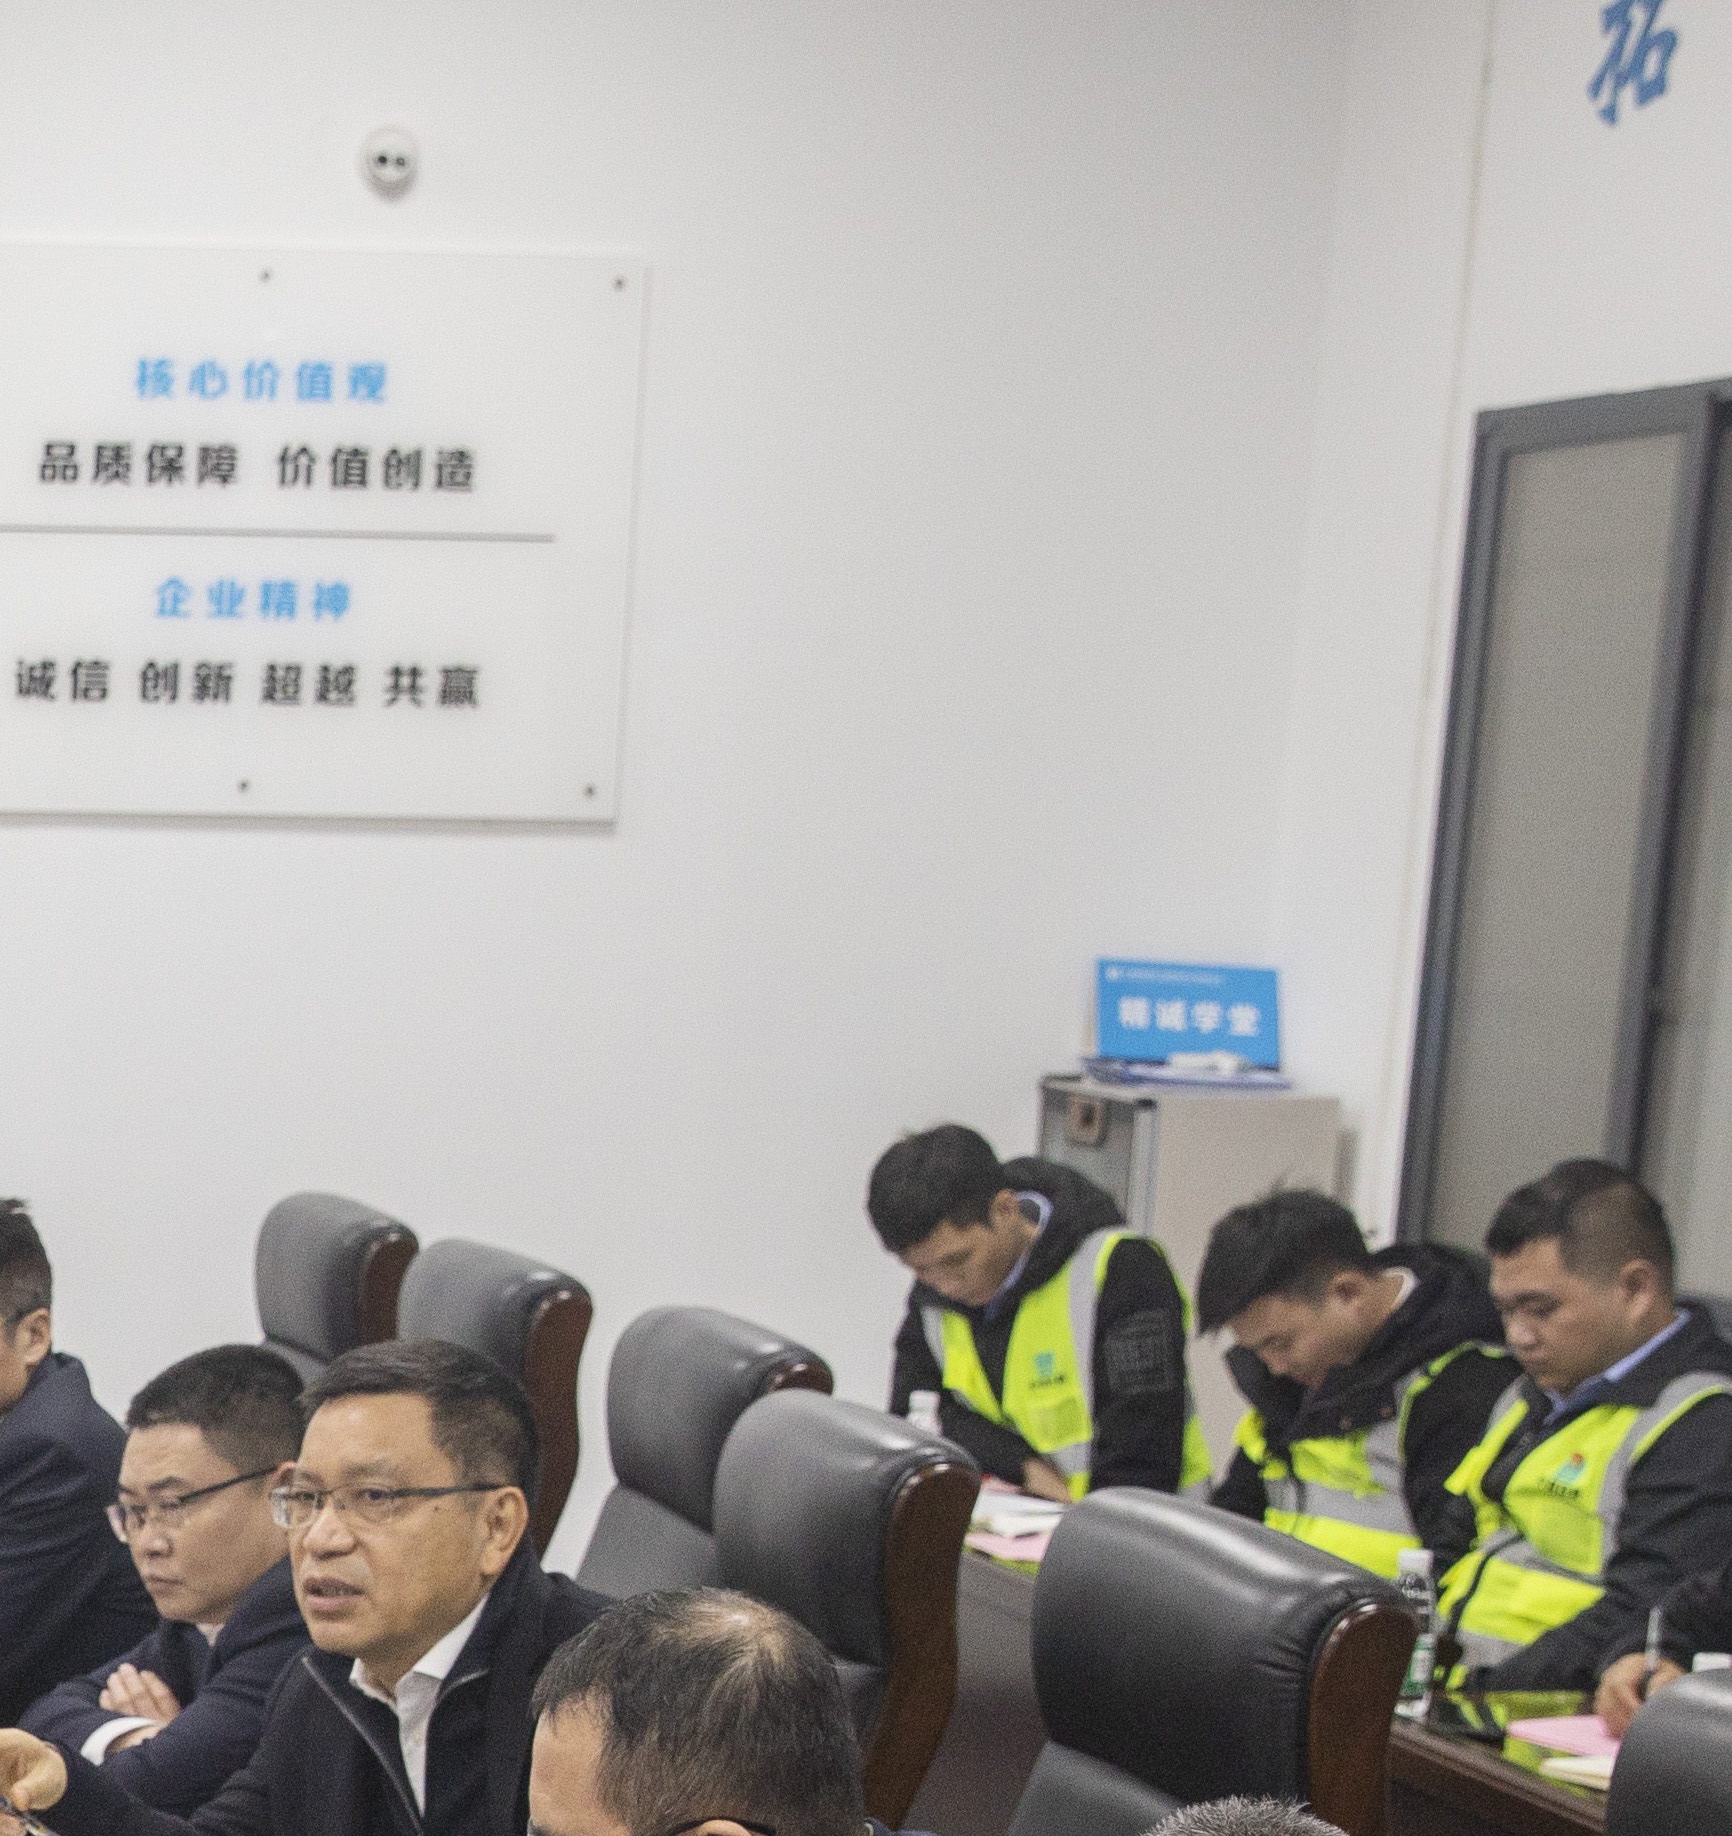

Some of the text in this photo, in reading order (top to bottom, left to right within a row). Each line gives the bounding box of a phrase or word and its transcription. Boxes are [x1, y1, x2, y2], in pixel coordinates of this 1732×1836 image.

[134, 357, 389, 405] 核心价值观
[38, 440, 476, 492] 品质保障 价值创造
[155, 576, 353, 621] 企业精神
[14, 658, 480, 708] 诚信 创新 超越 共赢
